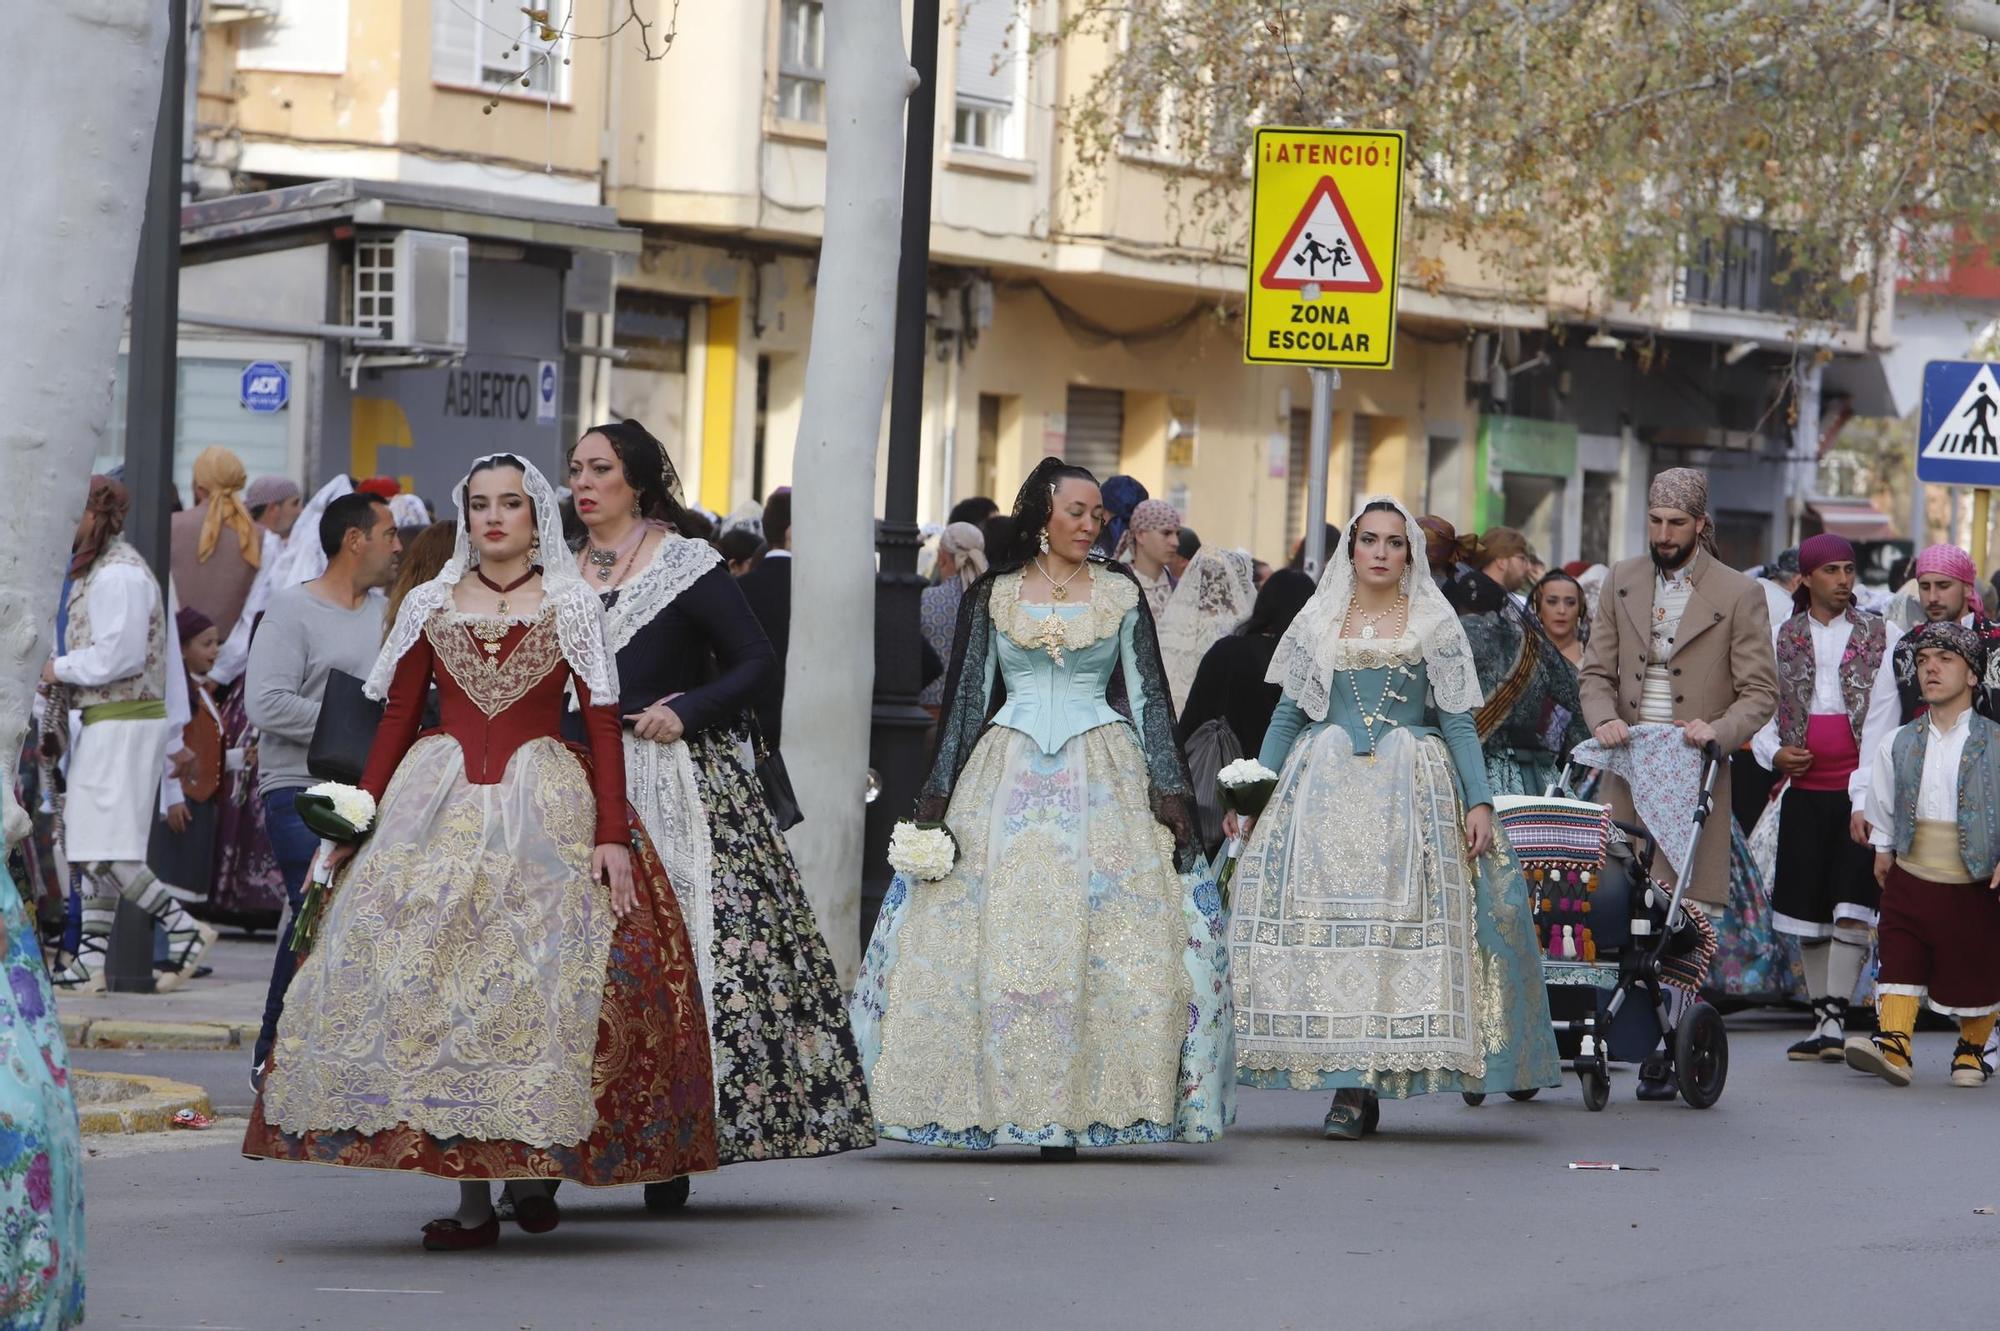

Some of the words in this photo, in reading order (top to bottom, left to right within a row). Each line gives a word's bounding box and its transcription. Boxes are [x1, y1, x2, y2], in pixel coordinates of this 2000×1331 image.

[1266, 141, 1390, 167] ¡ATENCIÓ!
[1291, 304, 1350, 324] ZONA
[1268, 330, 1370, 352] ESCOLAR
[249, 376, 281, 394] ADT
[444, 371, 531, 420] ABIERTO
